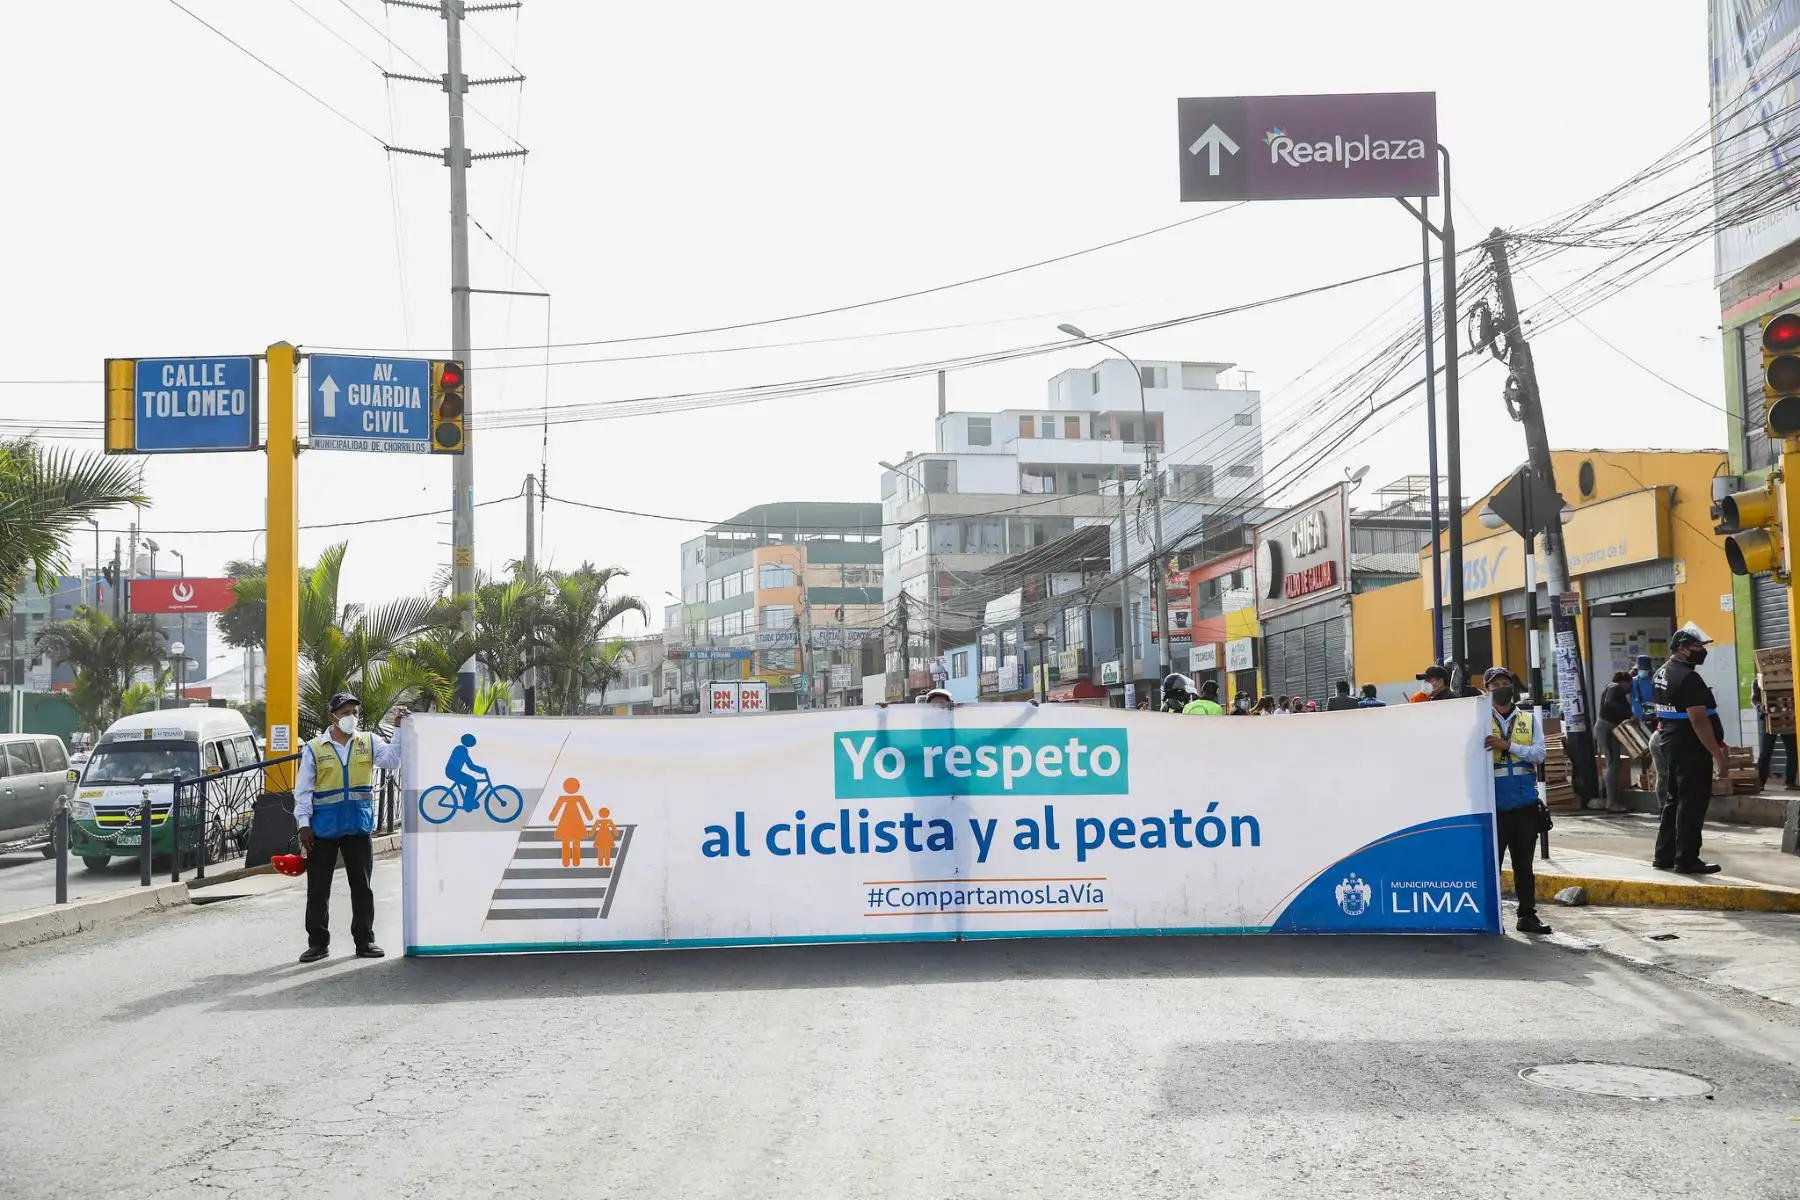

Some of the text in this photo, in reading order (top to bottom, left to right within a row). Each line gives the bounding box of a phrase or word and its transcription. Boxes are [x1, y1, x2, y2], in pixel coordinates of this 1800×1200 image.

[162, 363, 226, 387] CALLE
[373, 363, 398, 382] AV.
[142, 389, 245, 418] TOLOMEO
[348, 383, 421, 409] GUARDIA
[362, 410, 409, 433] CIVIL
[314, 440, 425, 452] MUNICIPALIDAD DE CHORRILLOS
[1290, 510, 1327, 558] CHIFA
[713, 691, 731, 700] DN
[742, 691, 759, 700] DN
[841, 737, 1120, 789] Yo respeto
[702, 801, 1261, 863] al ciclista y al peatón
[867, 883, 1105, 910] #CompartamosLaVía
[1391, 881, 1478, 889] MUNICIPALIDAD DE
[1392, 892, 1480, 914] LIMA
